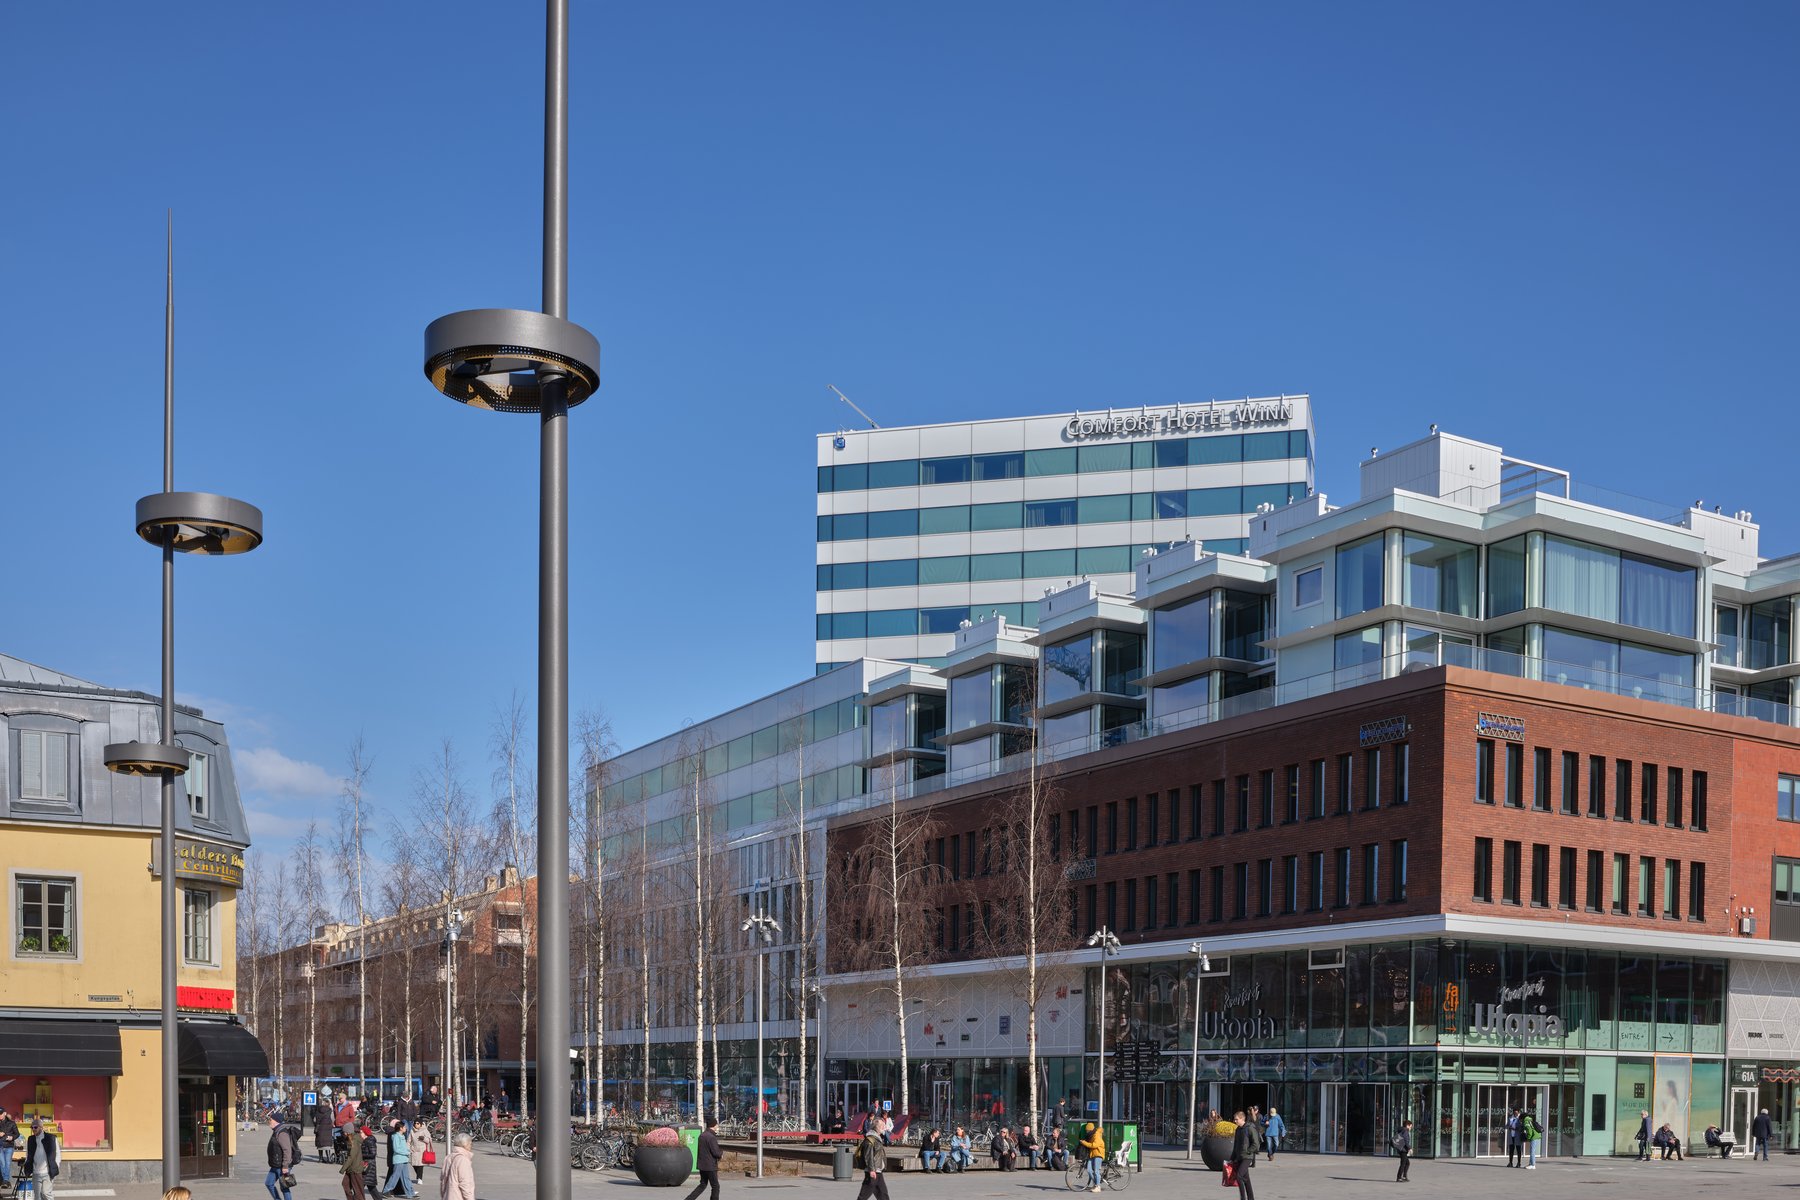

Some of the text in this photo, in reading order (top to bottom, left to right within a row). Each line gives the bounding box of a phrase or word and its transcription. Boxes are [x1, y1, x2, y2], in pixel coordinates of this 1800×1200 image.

[1065, 403, 1294, 437] COMFORT HOTEL WINN
[1204, 1009, 1275, 1047] Utopia
[1475, 1004, 1563, 1047] Utopia
[1741, 1071, 1755, 1082] 61A
